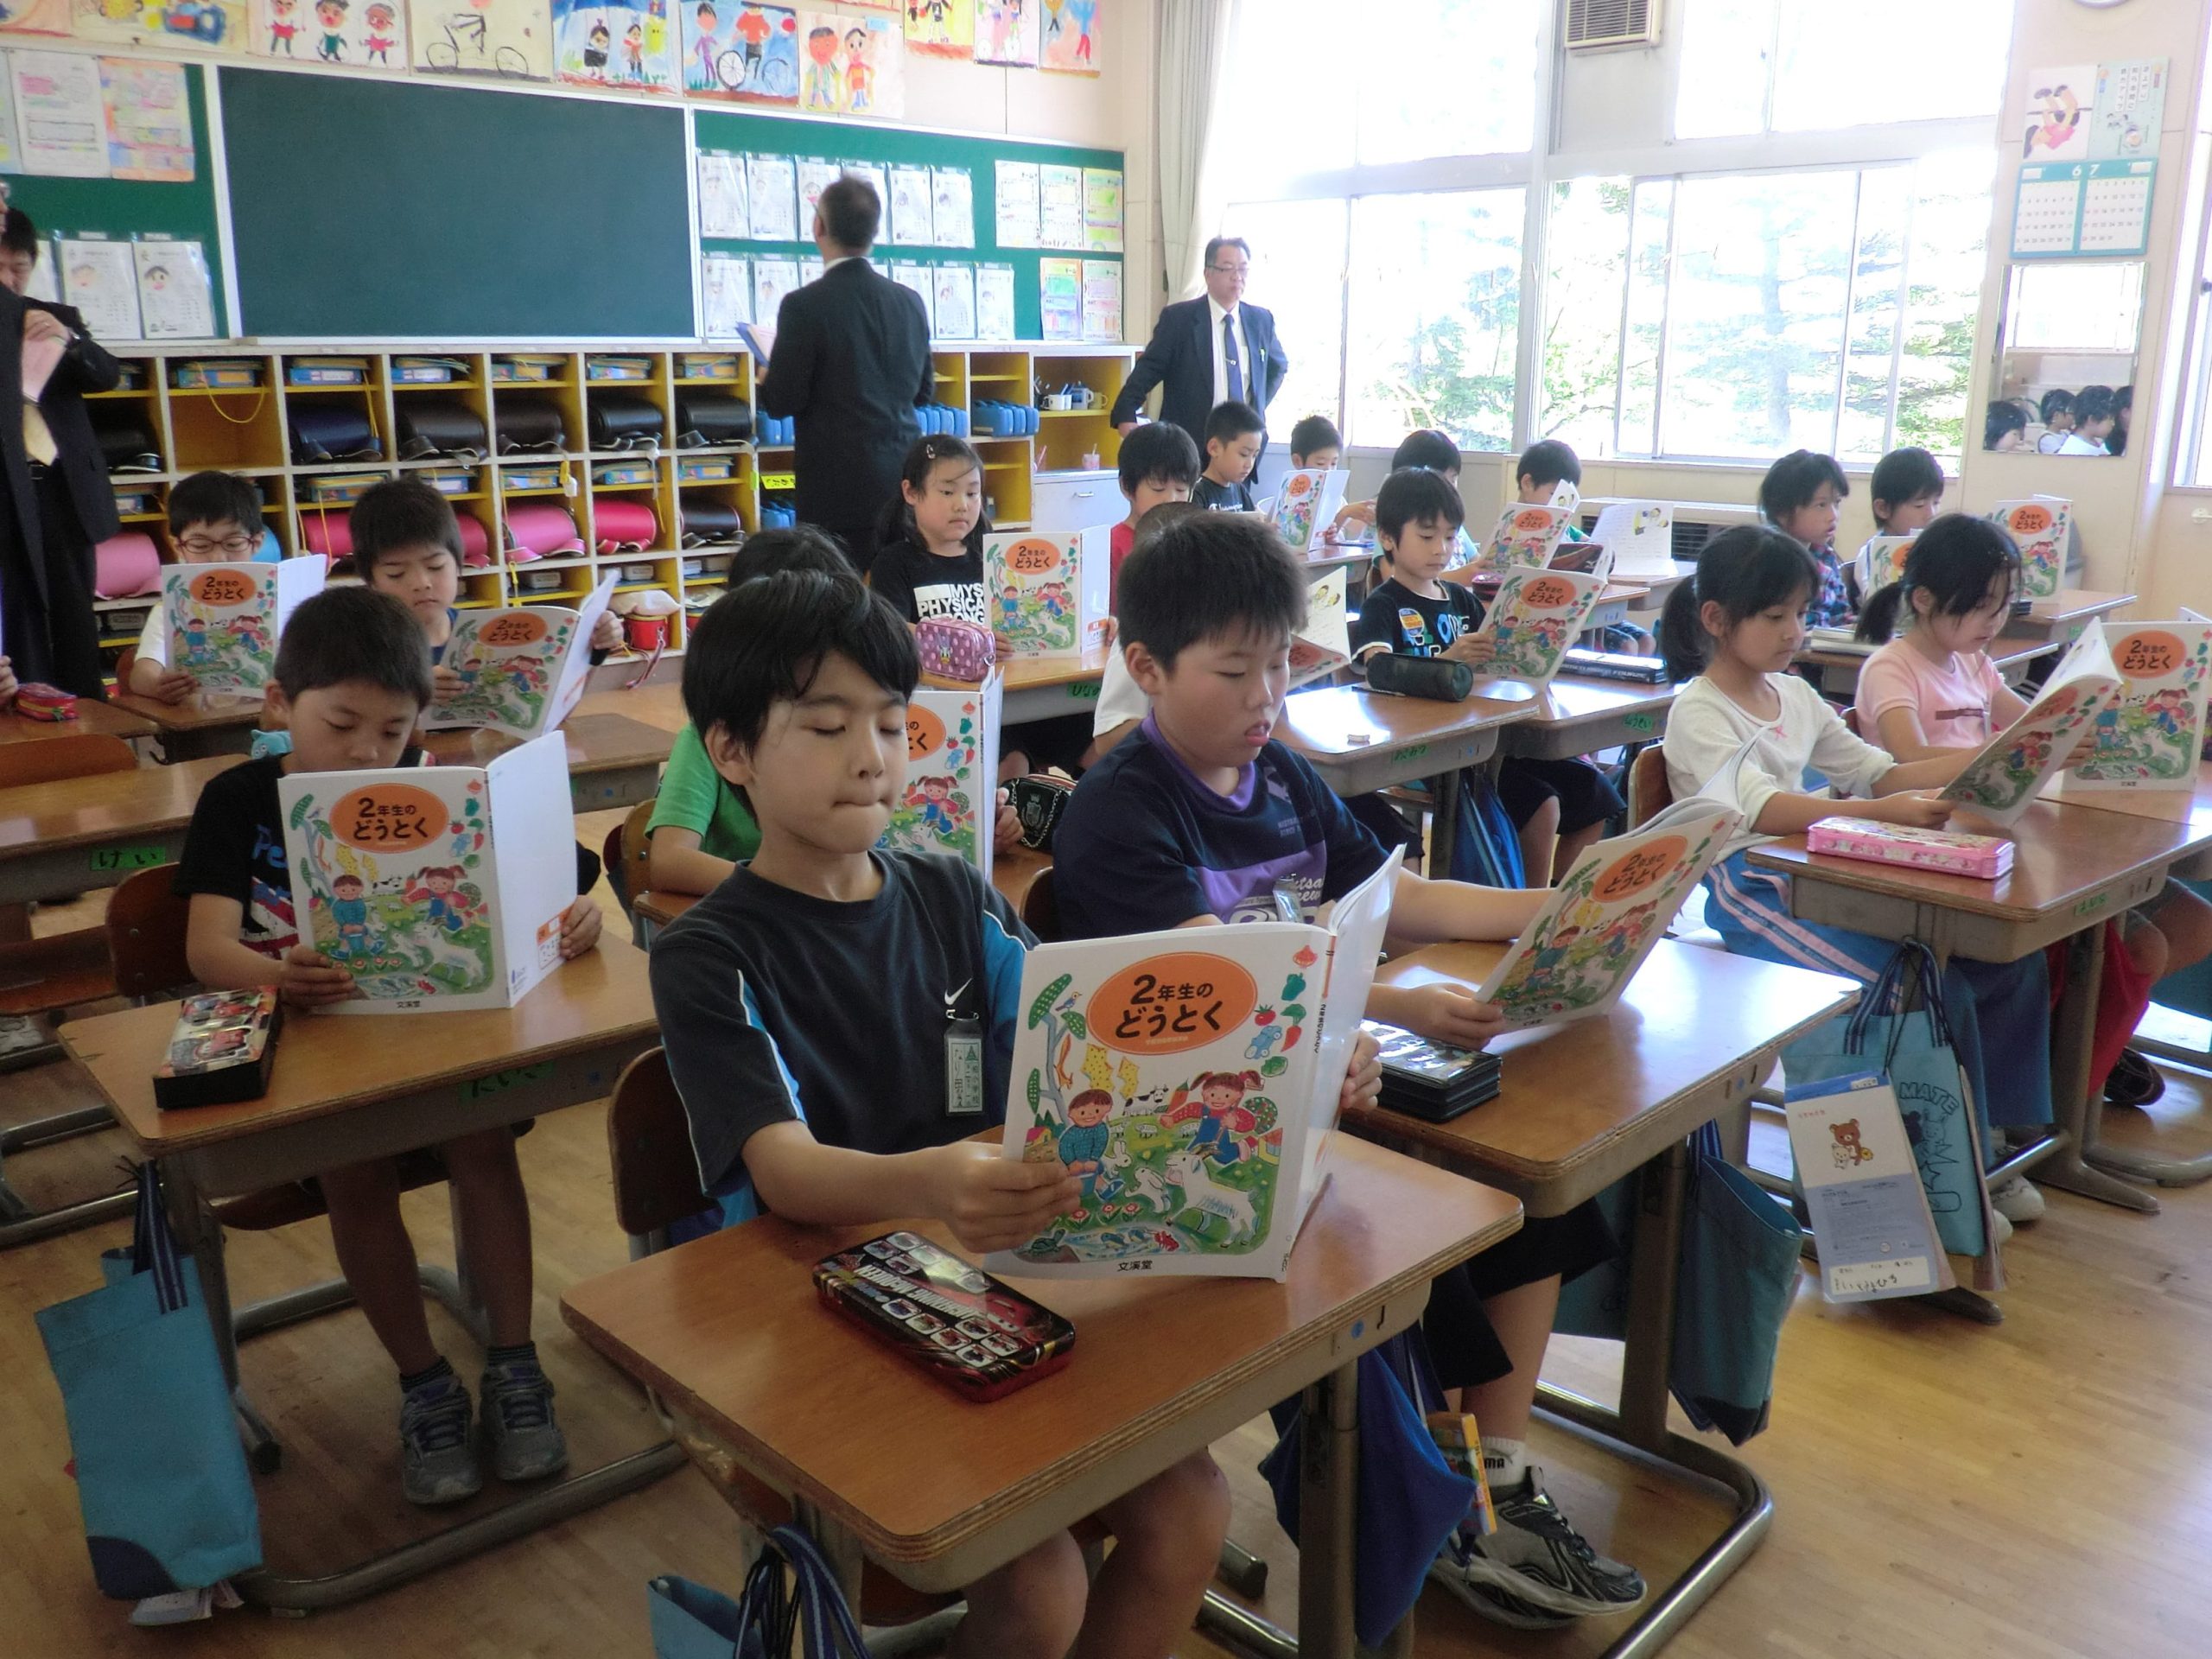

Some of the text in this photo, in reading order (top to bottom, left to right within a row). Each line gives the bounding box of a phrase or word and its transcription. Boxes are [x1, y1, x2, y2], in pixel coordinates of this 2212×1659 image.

[2072, 164, 2082, 176] 6
[2088, 163, 2100, 175] 7
[2014, 519, 2044, 530] どうとく
[1014, 557, 1051, 569] どうとく
[201, 588, 245, 601] どうとく
[1528, 593, 1565, 605] どうとく
[488, 629, 531, 642] どうとく
[2123, 654, 2172, 670] どうとく
[358, 797, 416, 818] 2年生の
[353, 817, 429, 842] どうとく
[1603, 862, 1666, 894] どうとく
[1130, 974, 1214, 1005] 2年生の
[1115, 1000, 1224, 1039] どうとく
